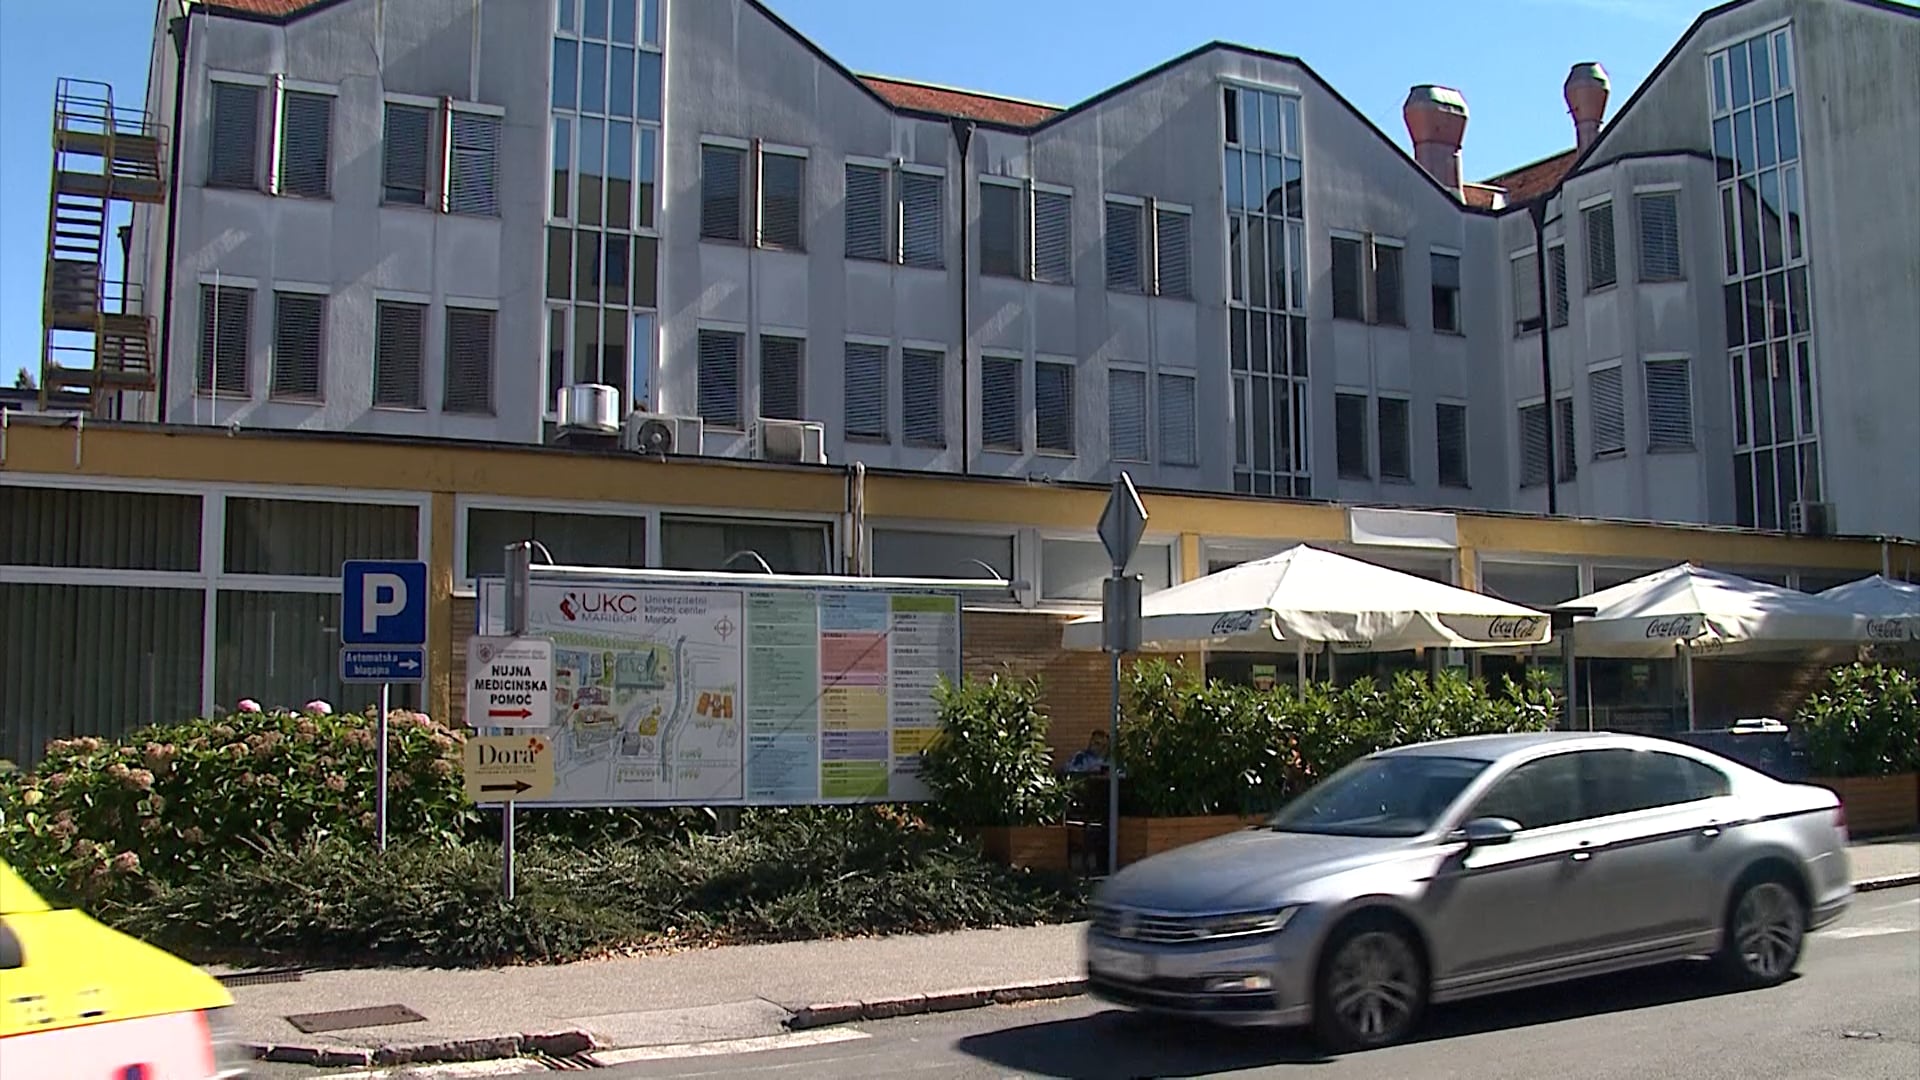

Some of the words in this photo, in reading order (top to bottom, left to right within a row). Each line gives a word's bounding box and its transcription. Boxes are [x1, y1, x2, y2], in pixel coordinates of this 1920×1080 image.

[362, 572, 407, 634] P
[582, 593, 637, 614] UKC
[491, 664, 532, 677] NUJNA
[474, 678, 548, 692] MEDICINSKA
[478, 744, 535, 766] Dora
